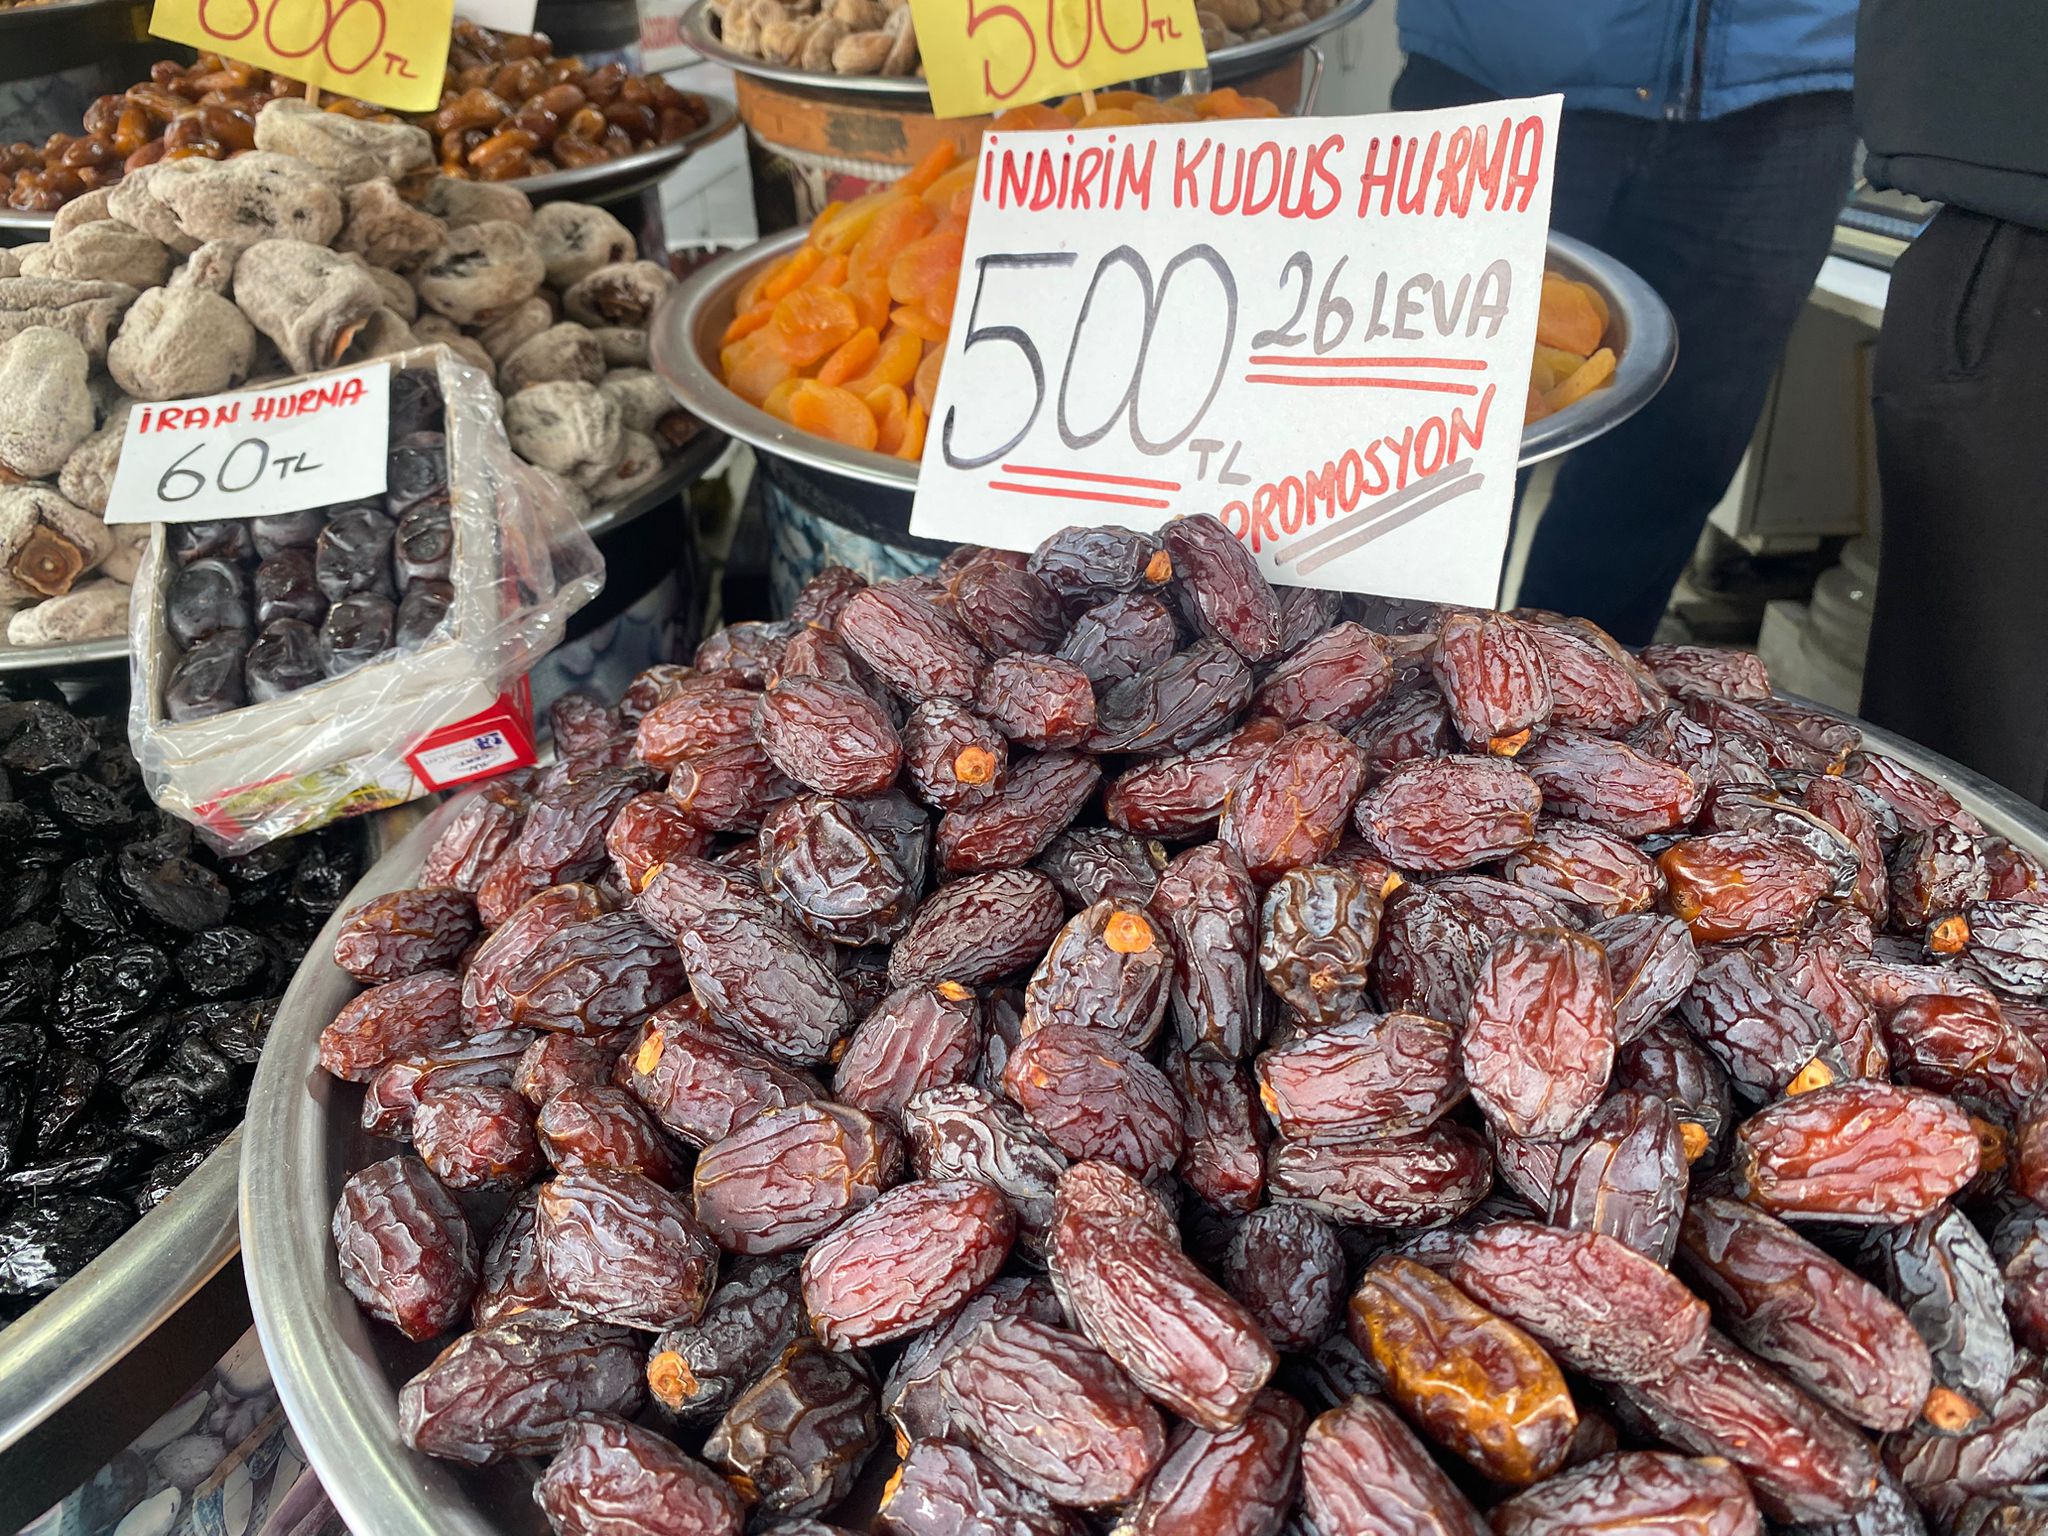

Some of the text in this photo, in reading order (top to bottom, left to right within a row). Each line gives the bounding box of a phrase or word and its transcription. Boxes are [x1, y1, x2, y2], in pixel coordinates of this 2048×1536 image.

[383, 52, 418, 79] TL
[967, 0, 1182, 100] 500 TL
[1173, 132, 1345, 220] KUDUS
[1357, 115, 1544, 219] HURMA
[1251, 250, 1512, 355] 26 LEVA
[941, 243, 1252, 486] 500 TL
[157, 437, 324, 502] 60 TL
